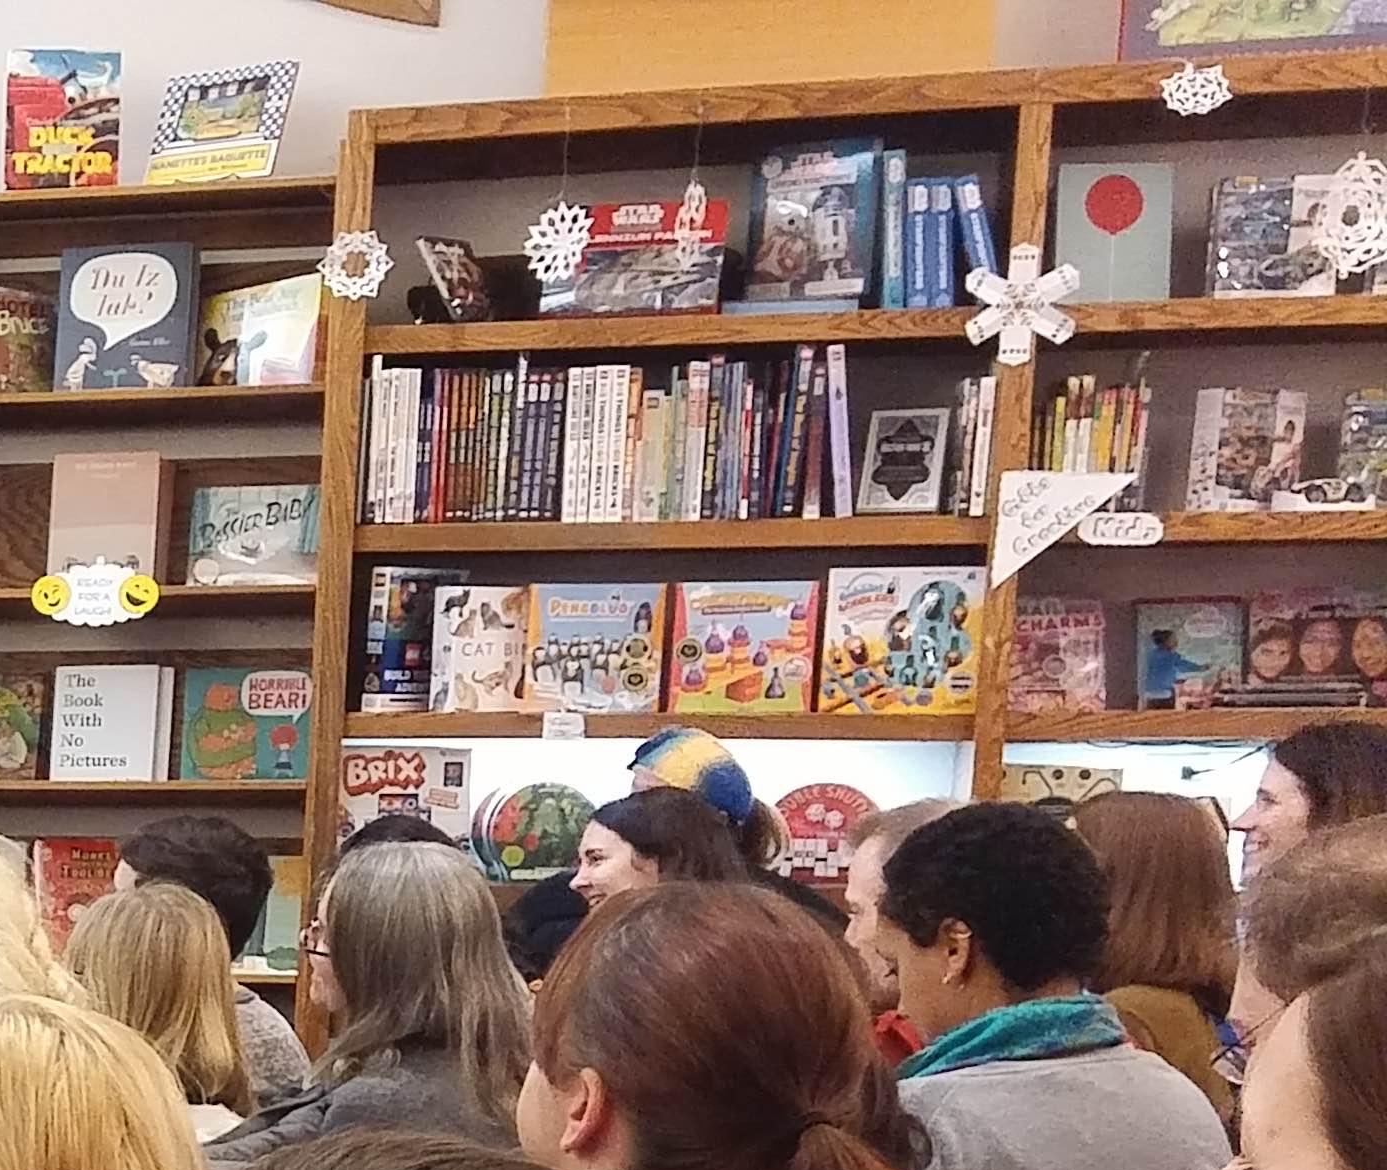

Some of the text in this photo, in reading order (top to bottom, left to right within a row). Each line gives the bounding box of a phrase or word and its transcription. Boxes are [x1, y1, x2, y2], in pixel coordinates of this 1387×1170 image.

[29, 126, 96, 147] DUCK
[12, 152, 113, 174] TRACTOR
[1092, 516, 1157, 539] Kids
[77, 578, 113, 587] READY
[78, 592, 111, 600] FOR A
[1016, 616, 1104, 632] CHARMS
[461, 642, 525, 657] CAT BI
[65, 674, 96, 689] The
[249, 677, 307, 692] HORRIBLE
[63, 694, 104, 708] Book
[248, 692, 307, 710] BEAR!
[61, 713, 103, 727] With
[60, 733, 85, 747] No
[59, 753, 128, 768] Pictures
[345, 754, 423, 790] BRIX
